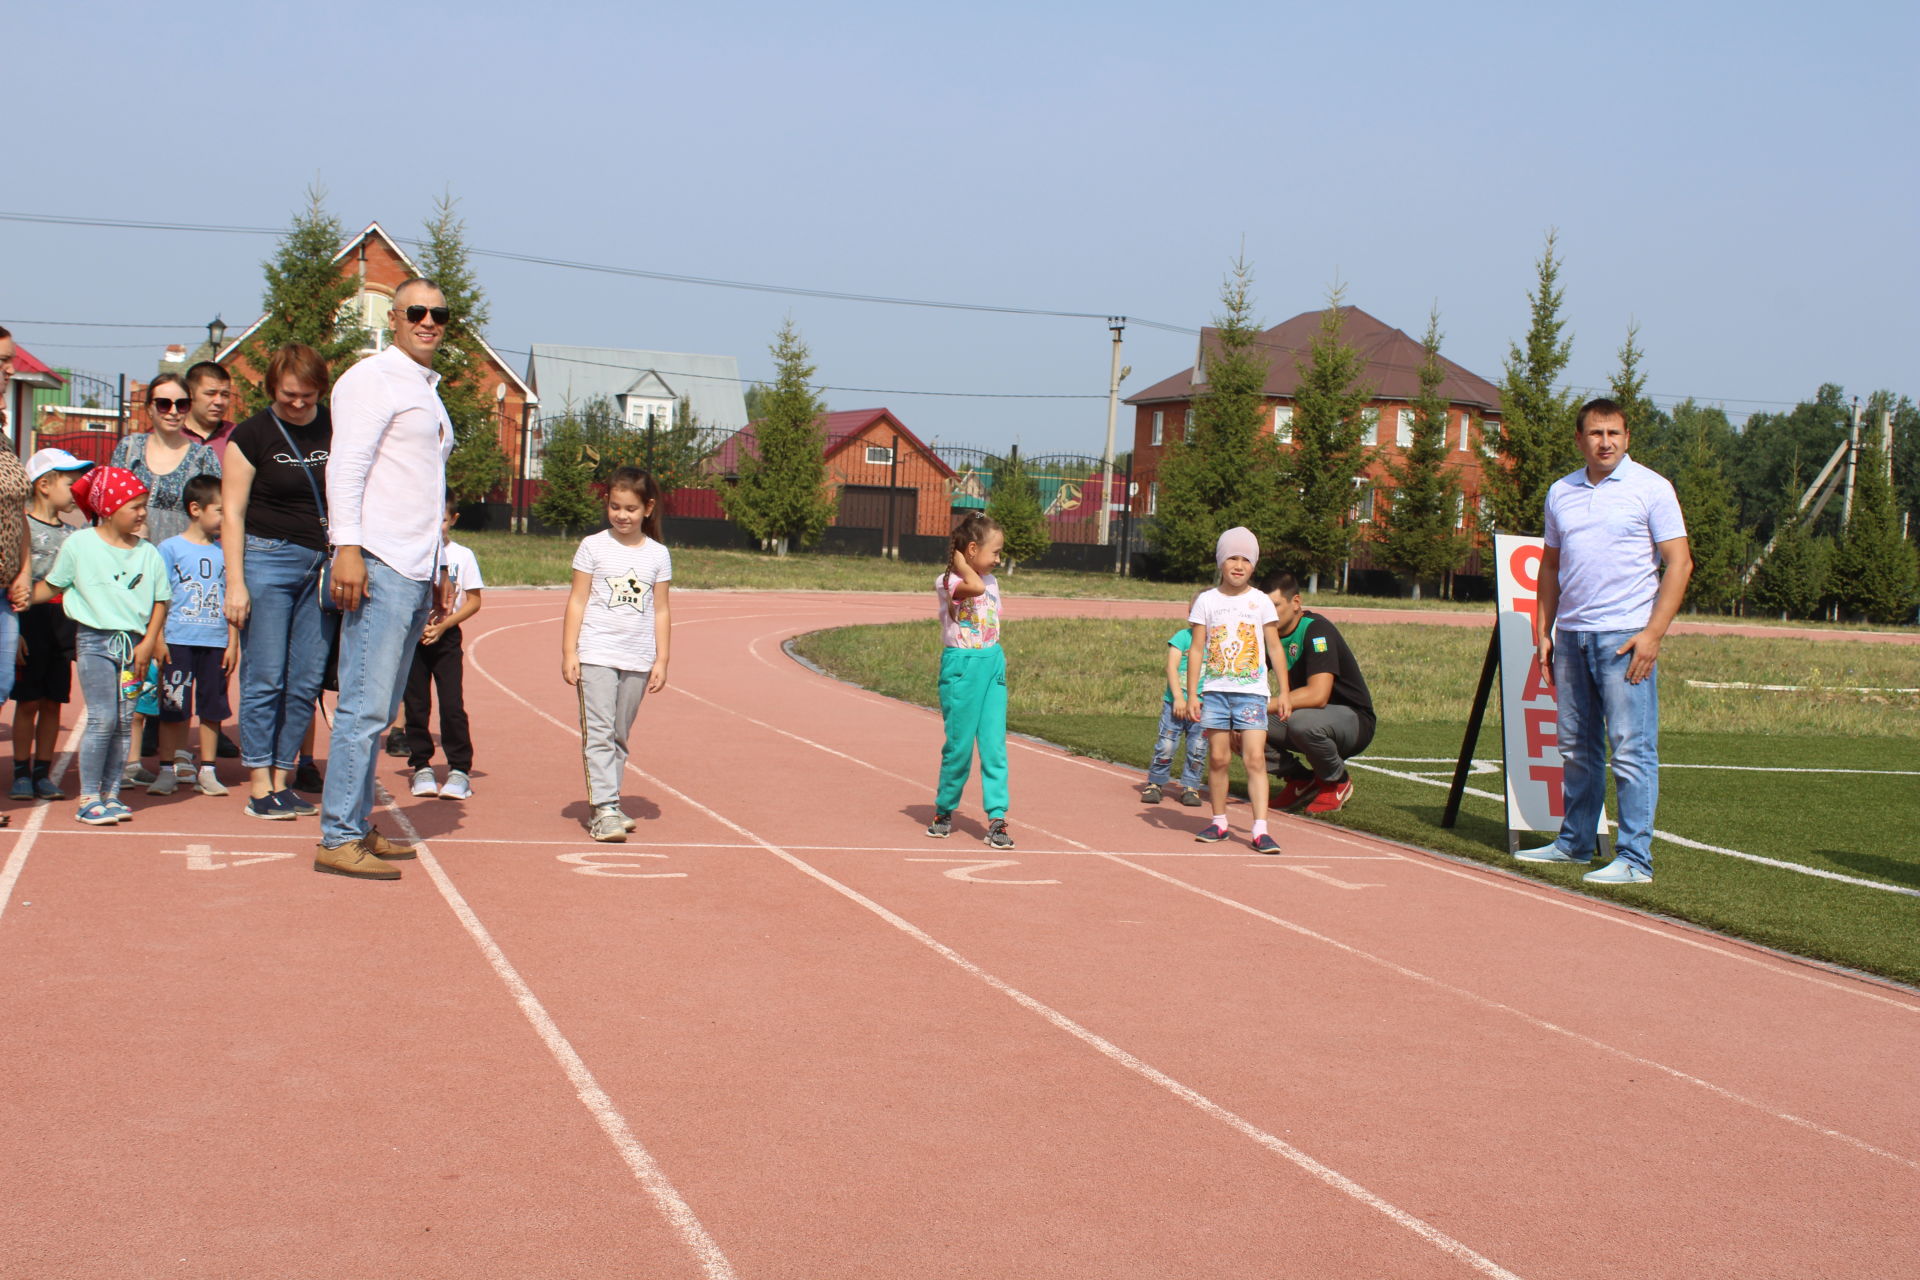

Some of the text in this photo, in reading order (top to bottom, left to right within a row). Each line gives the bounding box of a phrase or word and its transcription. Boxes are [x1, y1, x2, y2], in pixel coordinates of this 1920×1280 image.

[181, 582, 220, 617] 34
[160, 844, 297, 870] 4
[555, 852, 689, 878] 3
[903, 857, 1063, 885] 2
